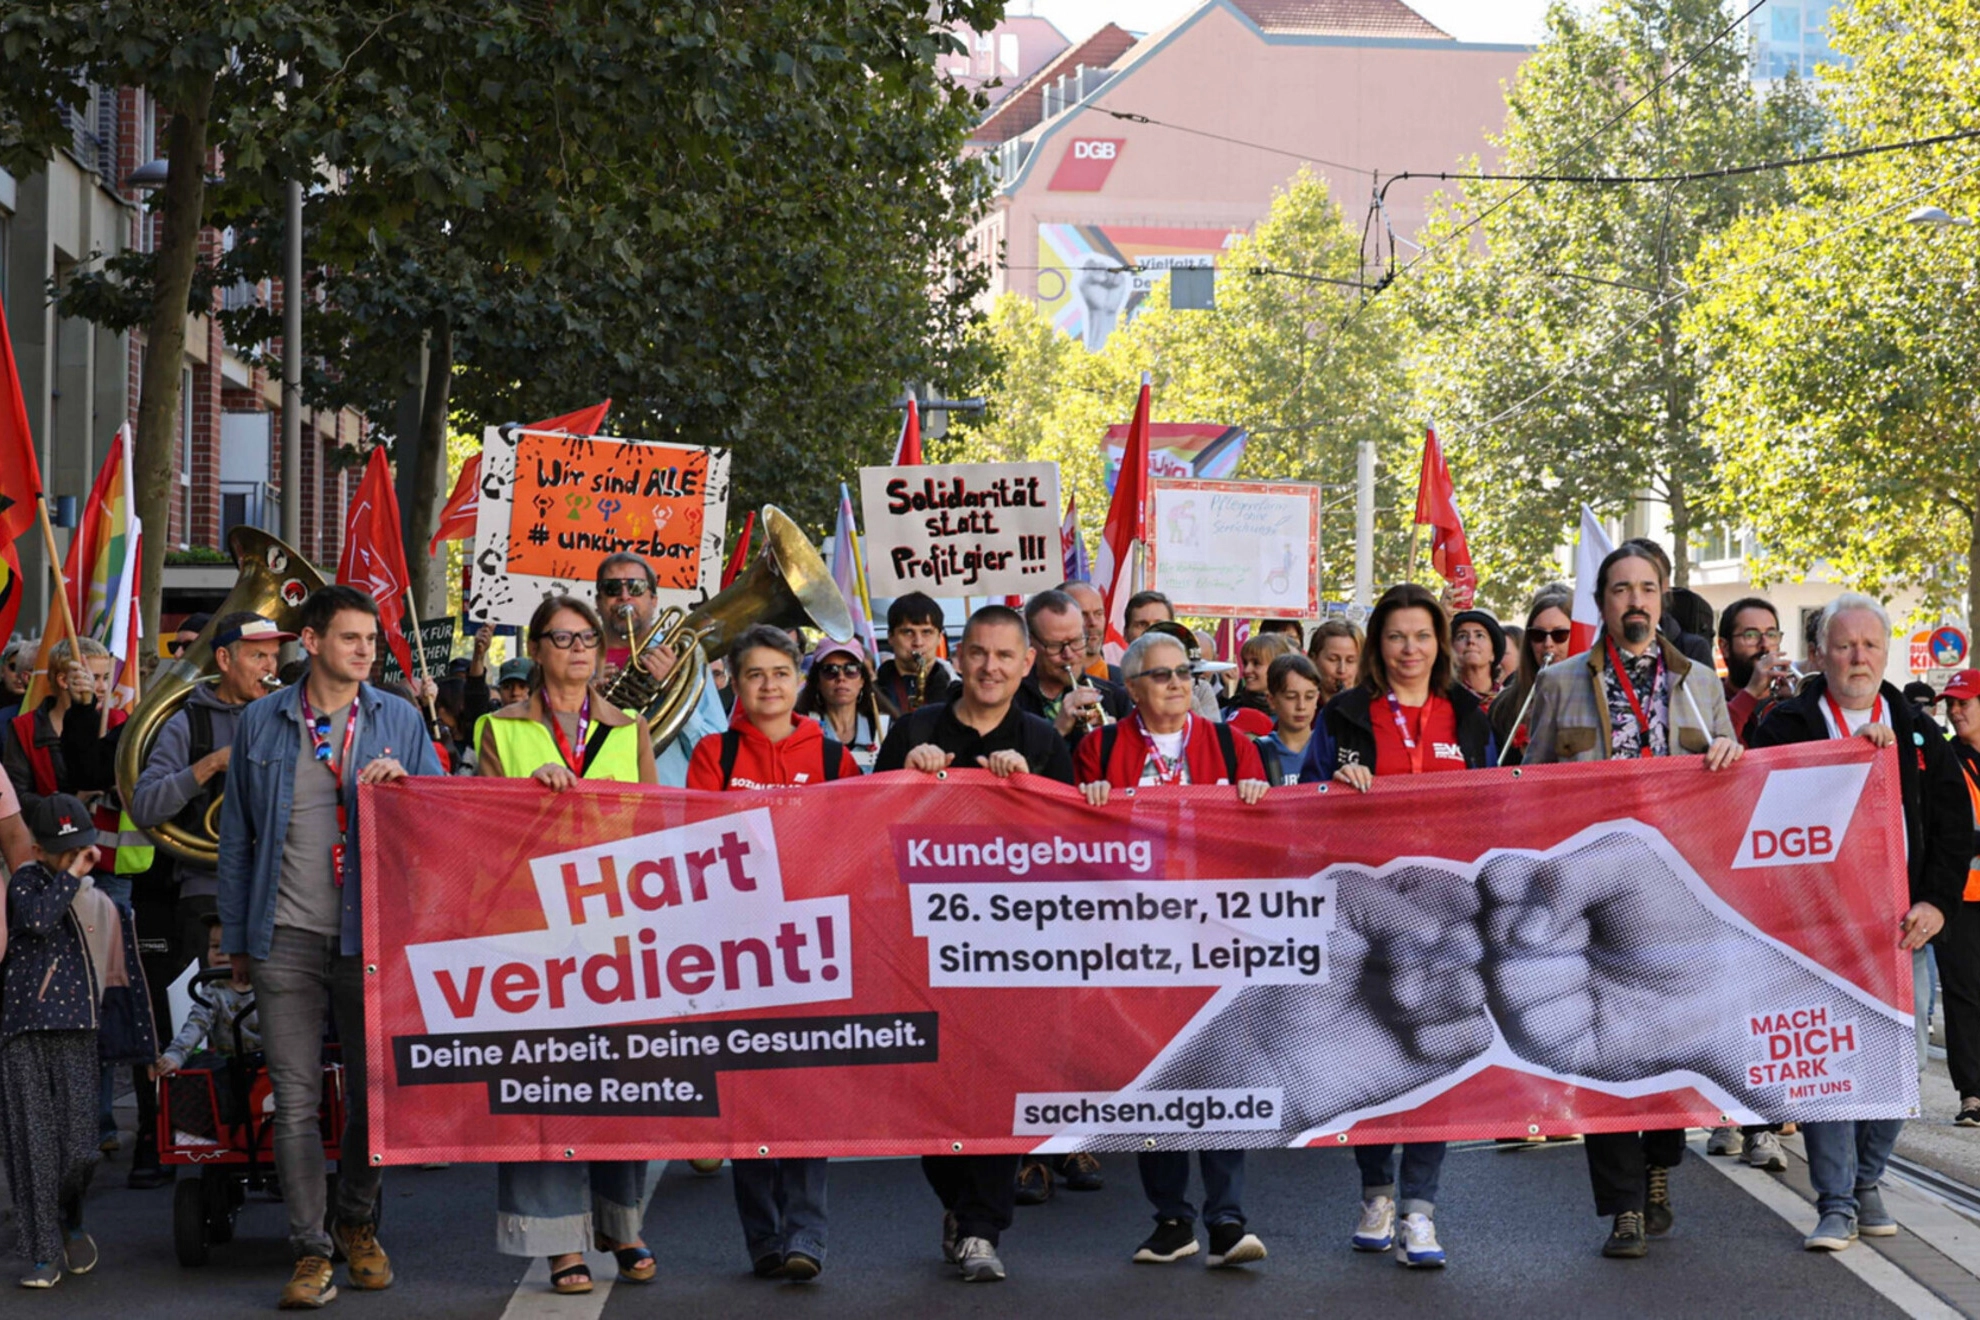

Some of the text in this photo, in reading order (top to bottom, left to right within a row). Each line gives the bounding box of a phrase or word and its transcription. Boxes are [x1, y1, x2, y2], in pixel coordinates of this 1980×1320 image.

[1074, 141, 1116, 159] DGB
[537, 458, 698, 497] Wir sind ALLE
[886, 476, 1046, 515] Solidarität
[925, 510, 1000, 537] statt
[430, 622, 453, 640] FÜR
[907, 836, 1152, 874] Kundgebung
[1752, 825, 1834, 860] DGB
[560, 831, 757, 926] Hart
[927, 890, 1325, 930] 26. September, 12 Uhr
[433, 915, 841, 1021] verdient!
[938, 938, 1321, 981] Simsonplatz, Leipzig
[1751, 1007, 1827, 1036] MACH
[411, 1020, 926, 1069] Deine Arbeit. Deine Gesundheit.
[1768, 1024, 1855, 1061] DICH
[1749, 1058, 1828, 1085] STARK
[1789, 1080, 1852, 1099] MIT UNS
[500, 1077, 703, 1103] Deine Rente.
[1024, 1095, 1274, 1128] sachsen.dgb.de
